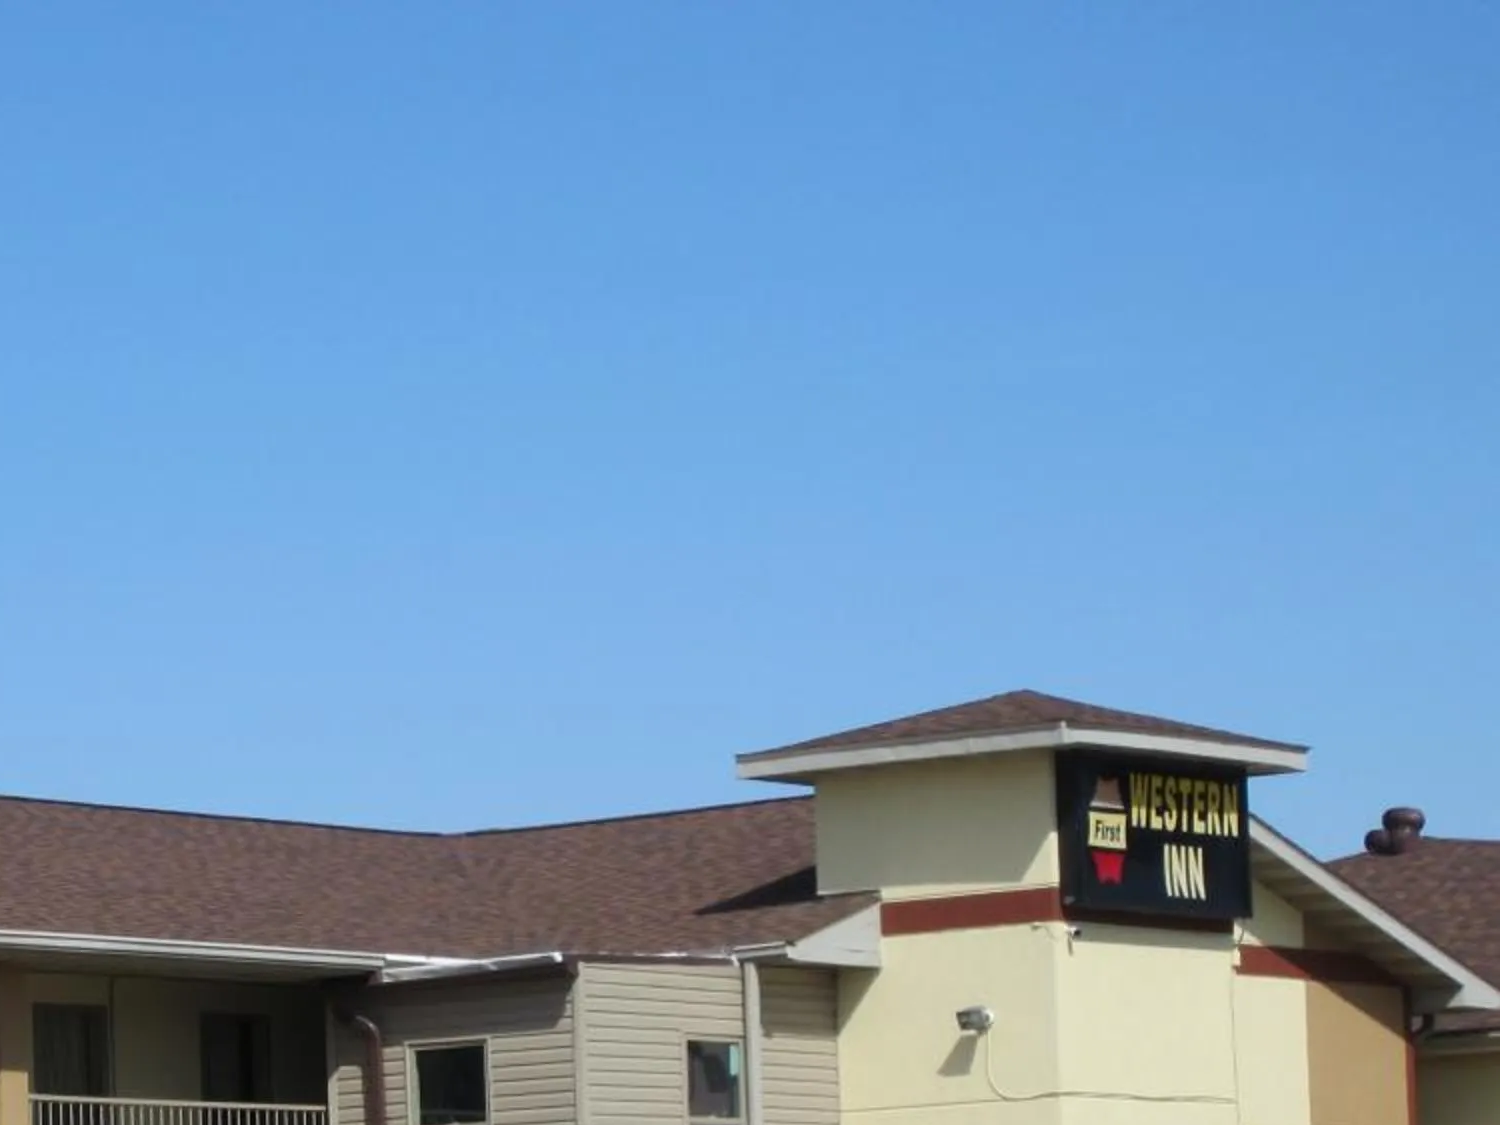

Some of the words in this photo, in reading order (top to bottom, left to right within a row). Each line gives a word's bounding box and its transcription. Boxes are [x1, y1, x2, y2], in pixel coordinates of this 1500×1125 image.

[1094, 822, 1122, 843] First
[1129, 772, 1239, 838] WESTERN
[1163, 843, 1206, 900] INN
